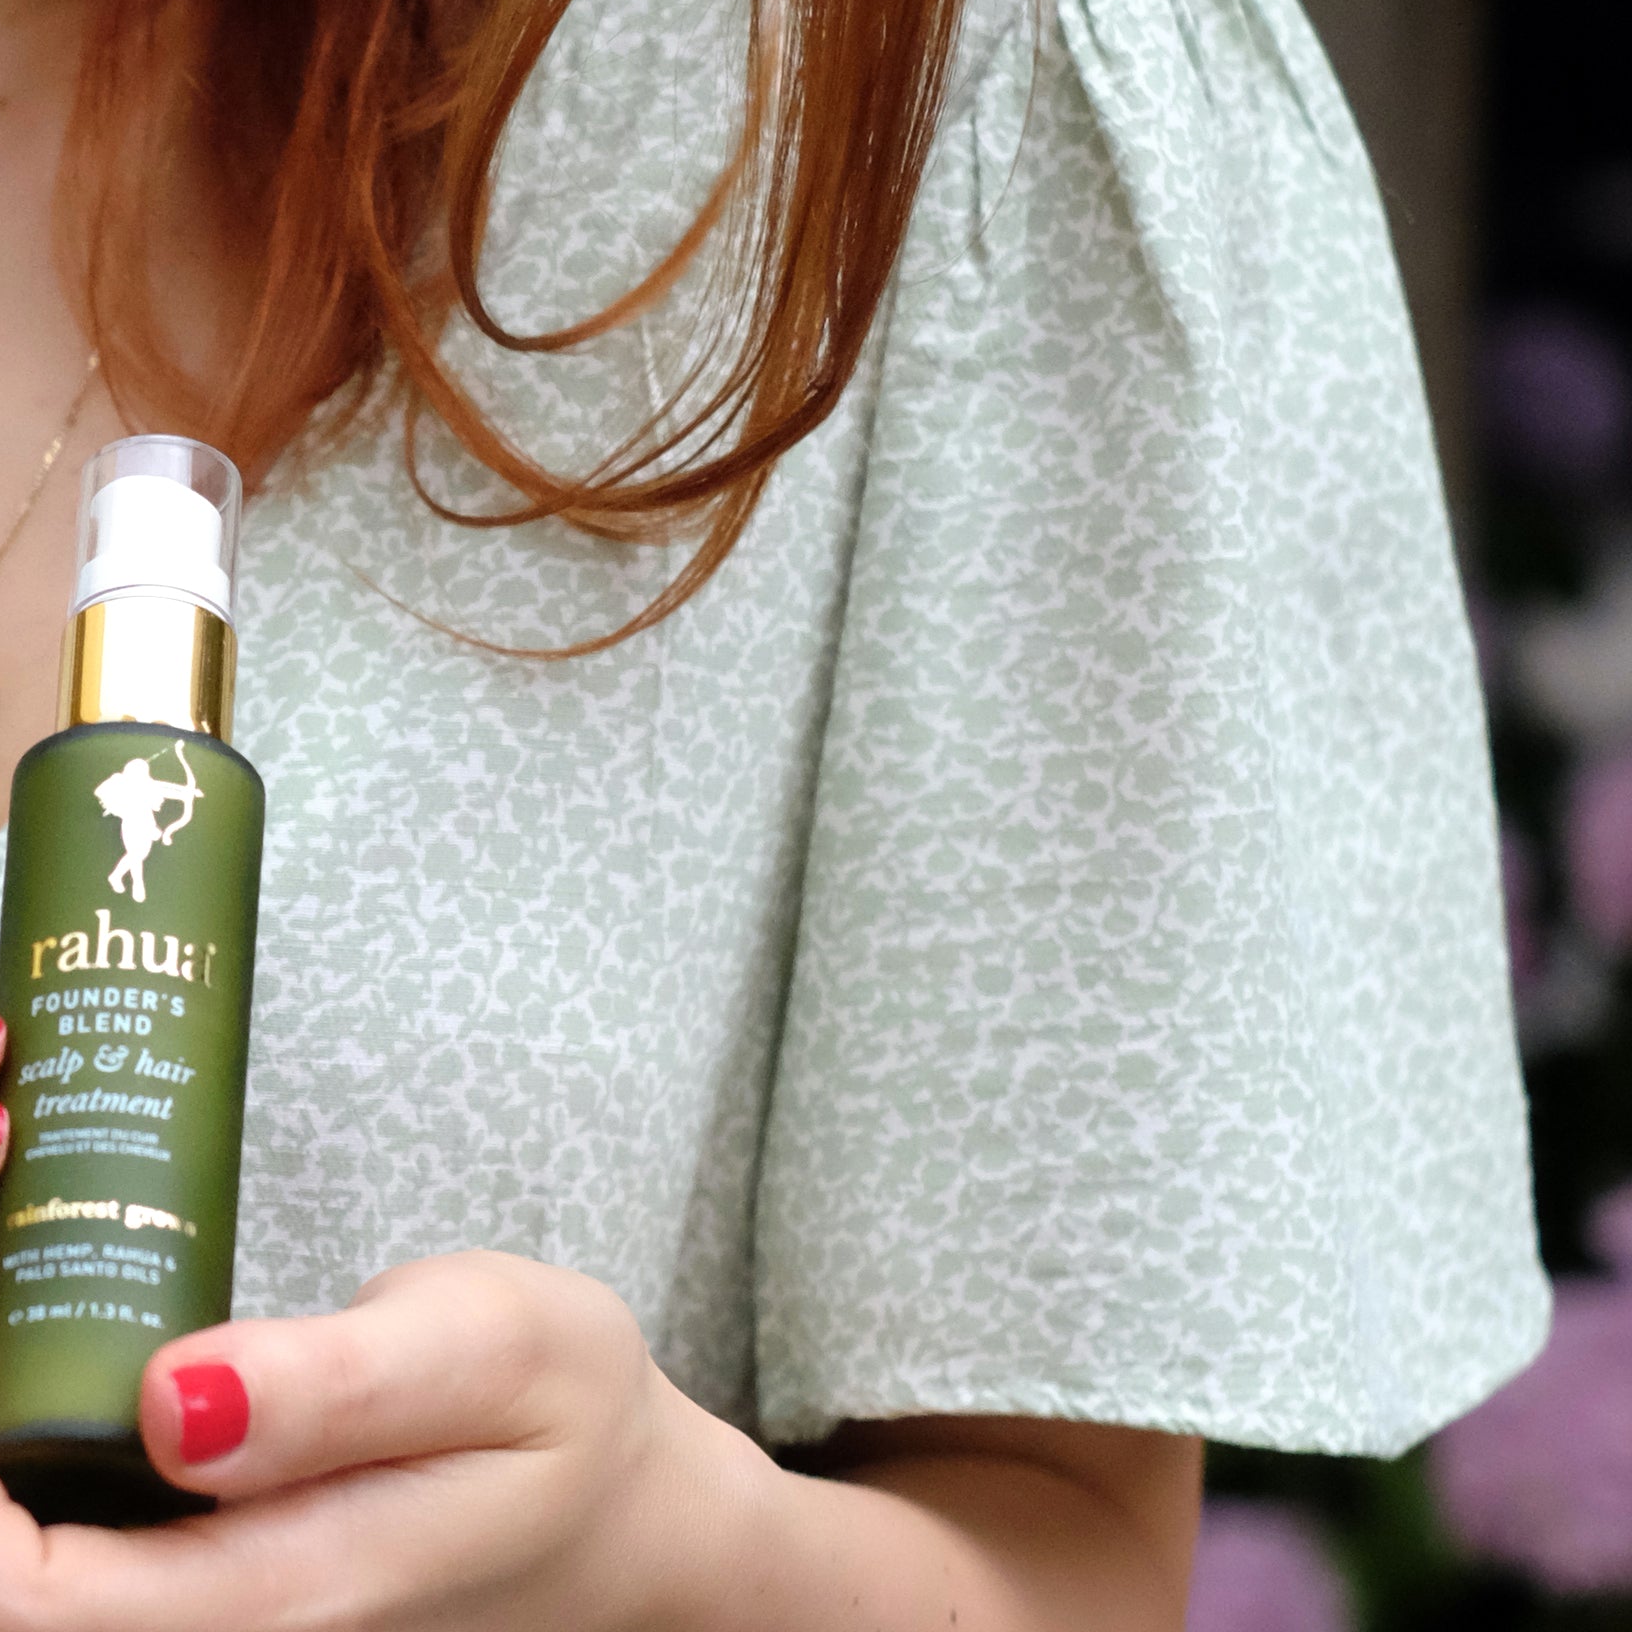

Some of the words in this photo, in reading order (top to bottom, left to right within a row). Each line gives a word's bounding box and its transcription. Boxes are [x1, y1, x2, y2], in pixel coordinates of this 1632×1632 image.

[30, 986, 186, 1018] FOUNDER'S
[58, 1011, 152, 1036] BLEND
[18, 1046, 84, 1085] scalp
[93, 1044, 130, 1072] &
[134, 1047, 197, 1085] hair
[33, 1086, 174, 1120] treatment
[15, 1263, 57, 1283] PALO
[59, 1260, 118, 1279] SANTO
